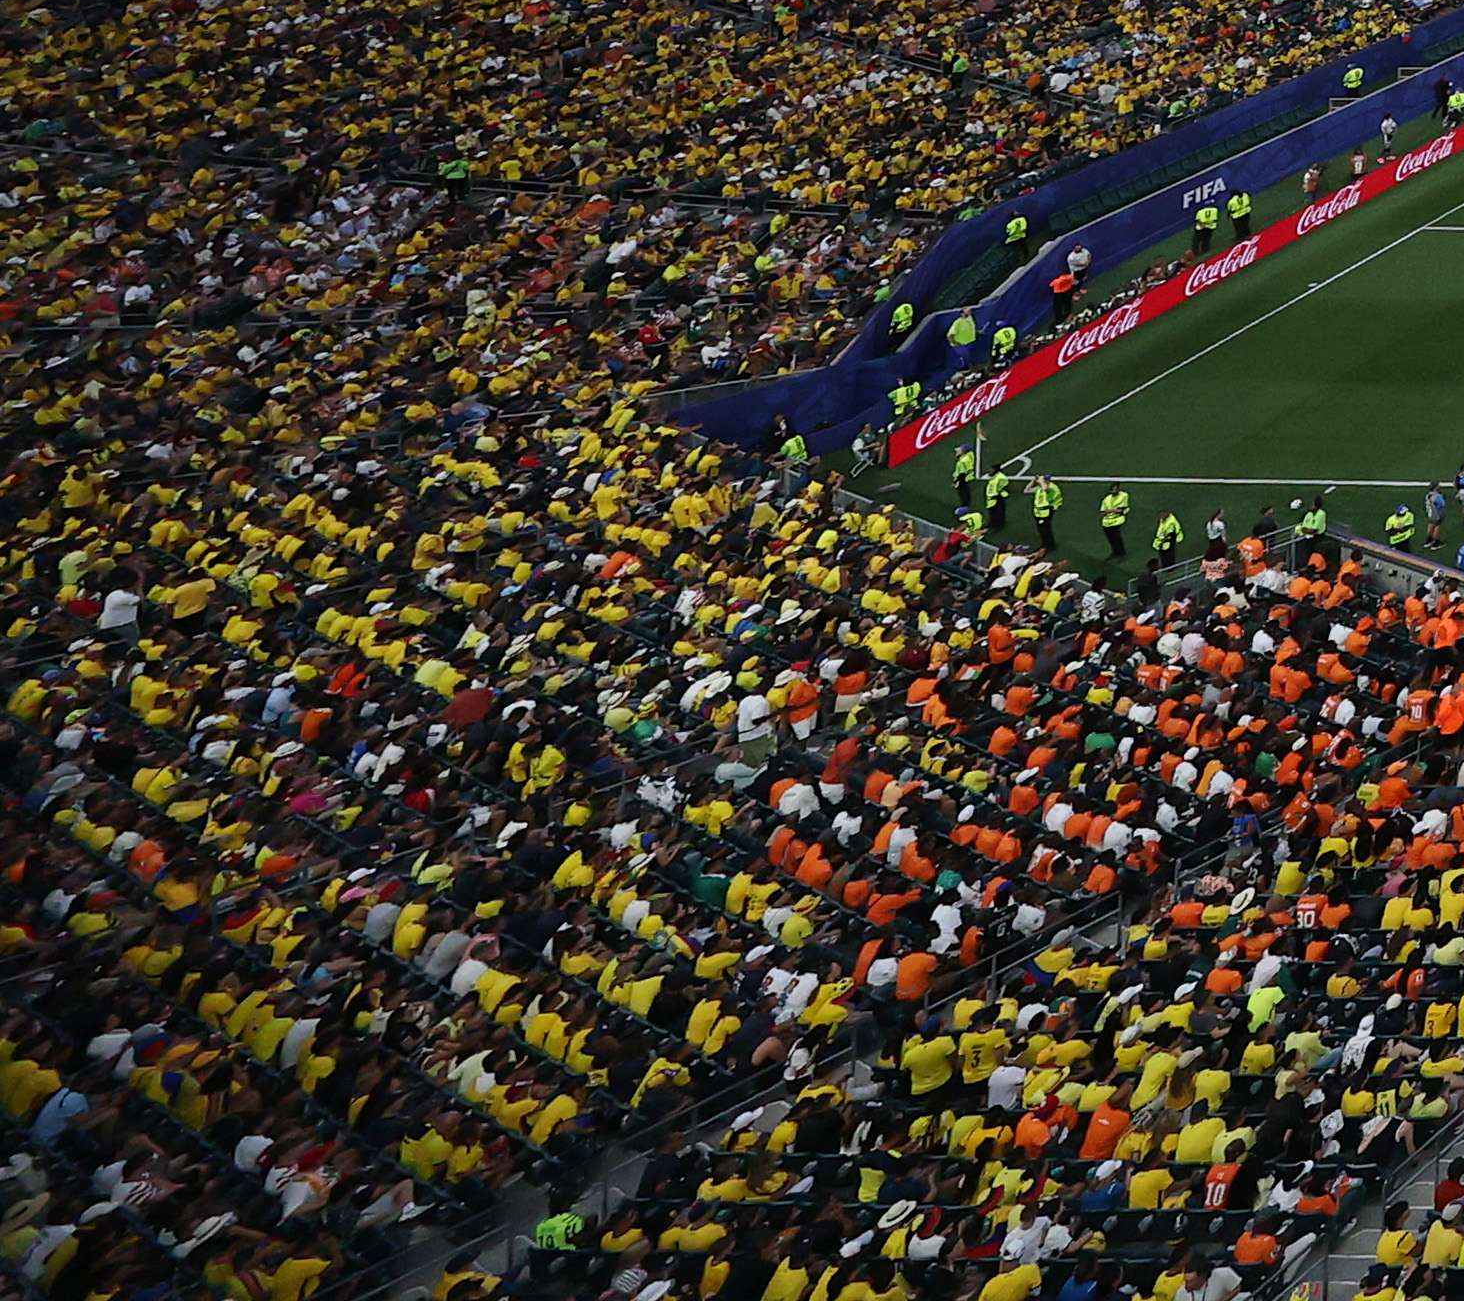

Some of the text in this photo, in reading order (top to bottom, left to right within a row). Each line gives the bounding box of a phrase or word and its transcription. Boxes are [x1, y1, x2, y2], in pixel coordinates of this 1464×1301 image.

[1395, 131, 1456, 181] Coca-Cola
[1182, 177, 1227, 211] FIFA
[1297, 181, 1362, 236] Coca-Cola
[1185, 236, 1259, 296] Coca-Cola
[1057, 300, 1144, 368] Coca-Cola
[915, 373, 1010, 449] Coca-Cola
